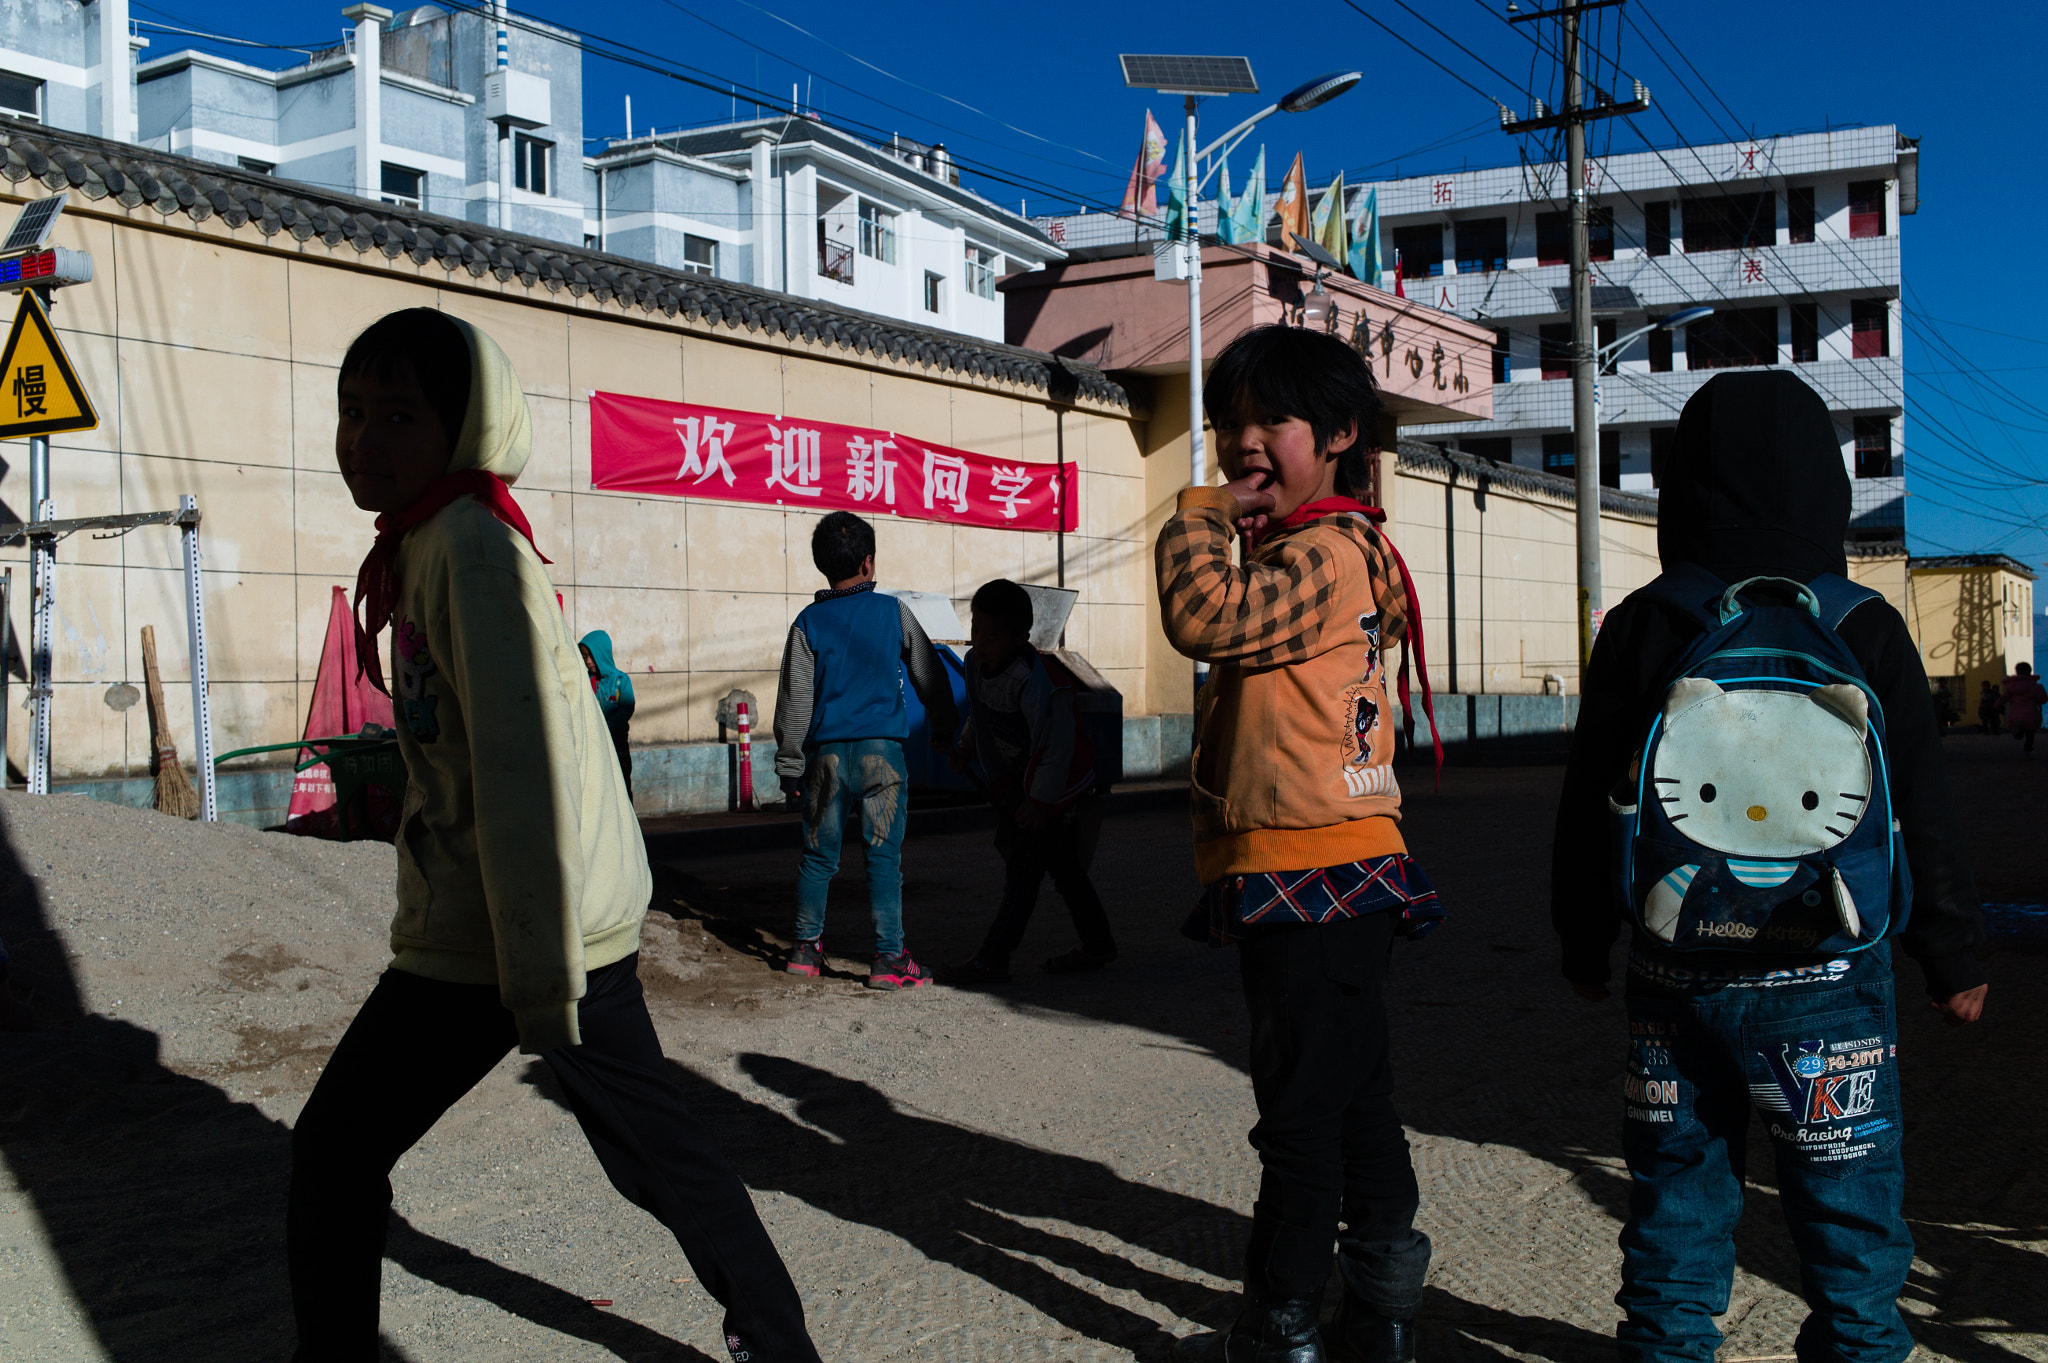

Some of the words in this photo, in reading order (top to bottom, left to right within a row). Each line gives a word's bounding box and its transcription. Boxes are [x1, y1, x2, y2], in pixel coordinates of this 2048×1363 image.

[1048, 222, 1066, 243] 振
[1434, 180, 1454, 204] 拓
[1741, 146, 1760, 171] 才
[1437, 286, 1455, 310] 人
[1742, 259, 1764, 283] 表
[13, 365, 47, 418] 慢
[1696, 920, 1759, 939] Hello
[1801, 1059, 1822, 1071] 29
[1827, 1048, 1884, 1071] FG-20YT
